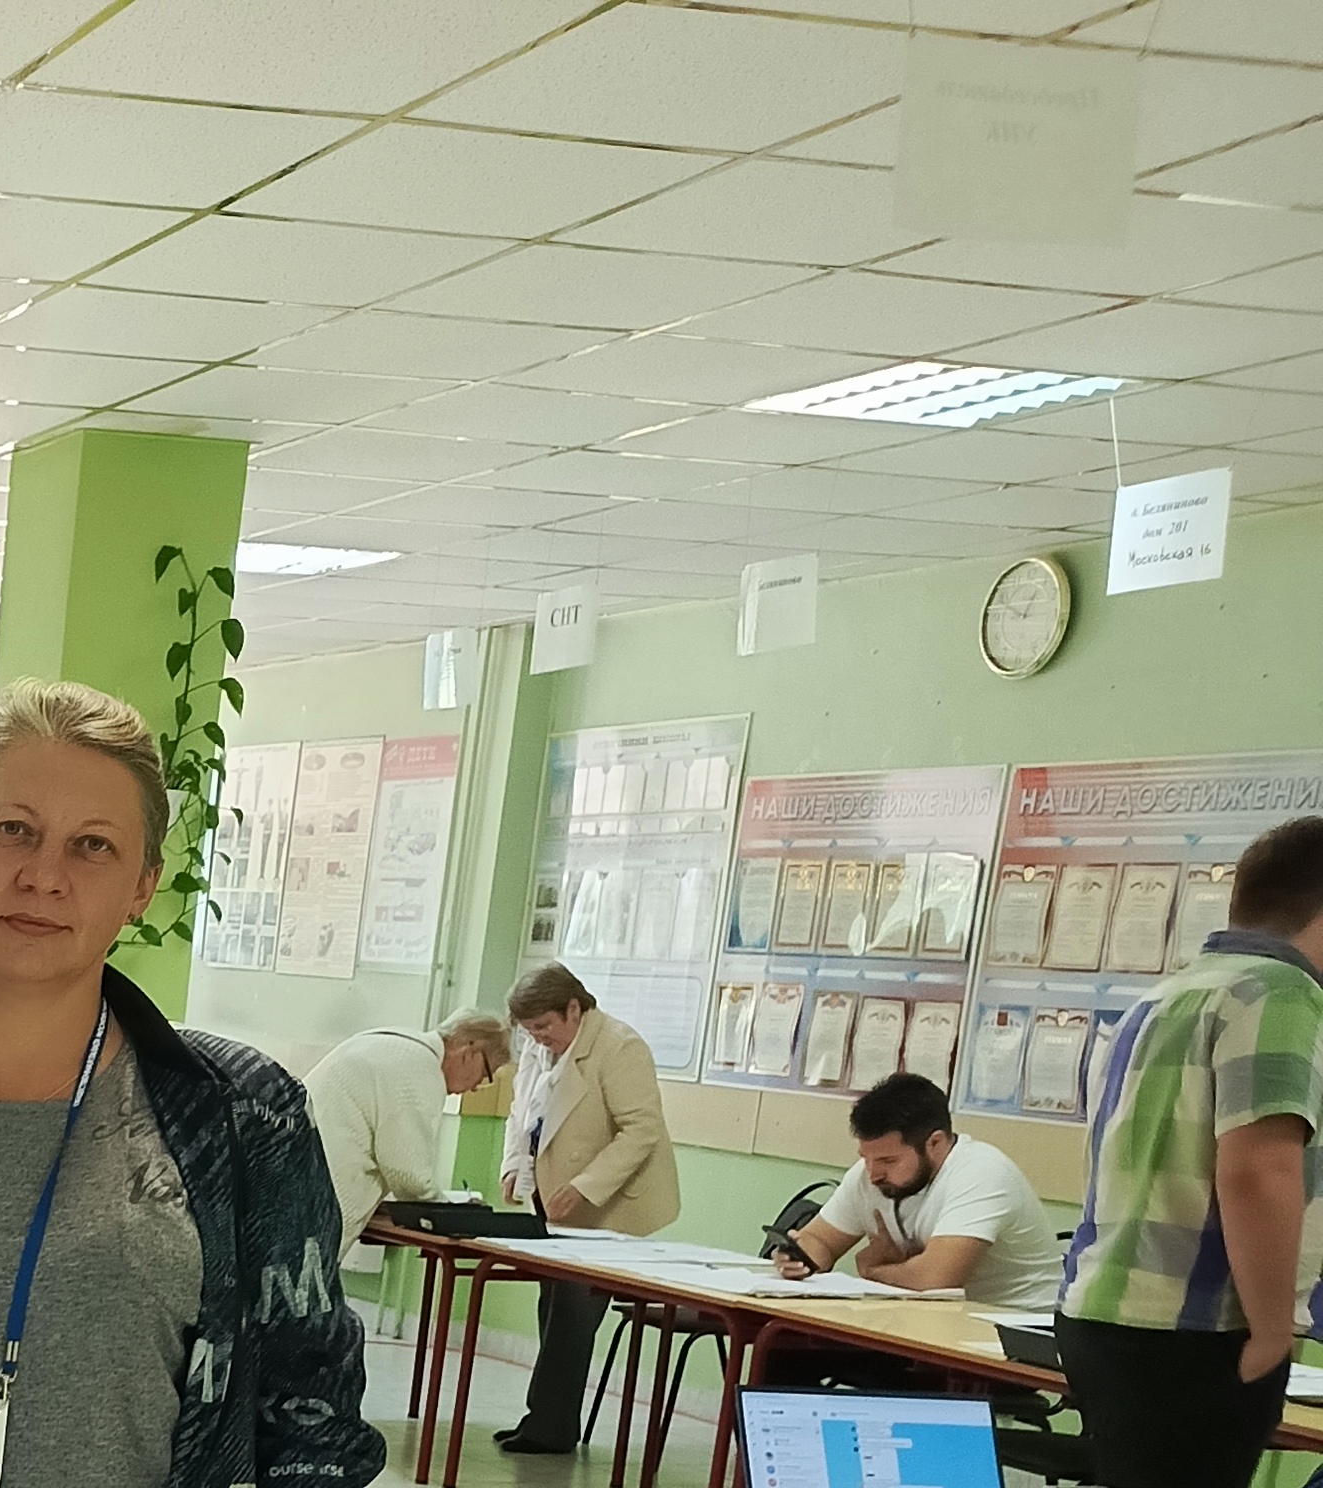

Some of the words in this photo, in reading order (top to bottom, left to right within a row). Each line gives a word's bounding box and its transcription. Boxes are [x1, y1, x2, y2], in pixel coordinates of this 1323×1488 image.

[1167, 520, 1189, 535] 201
[1127, 546, 1194, 569] Московская
[1200, 543, 1212, 557] 16
[550, 603, 583, 628] СНТ
[751, 796, 815, 821] НАШИ
[821, 787, 993, 824] ДОСТИЖЕНИЯ
[1018, 785, 1106, 816] НАШИ
[1113, 777, 1323, 818] ДОСТИЖЕНИ
